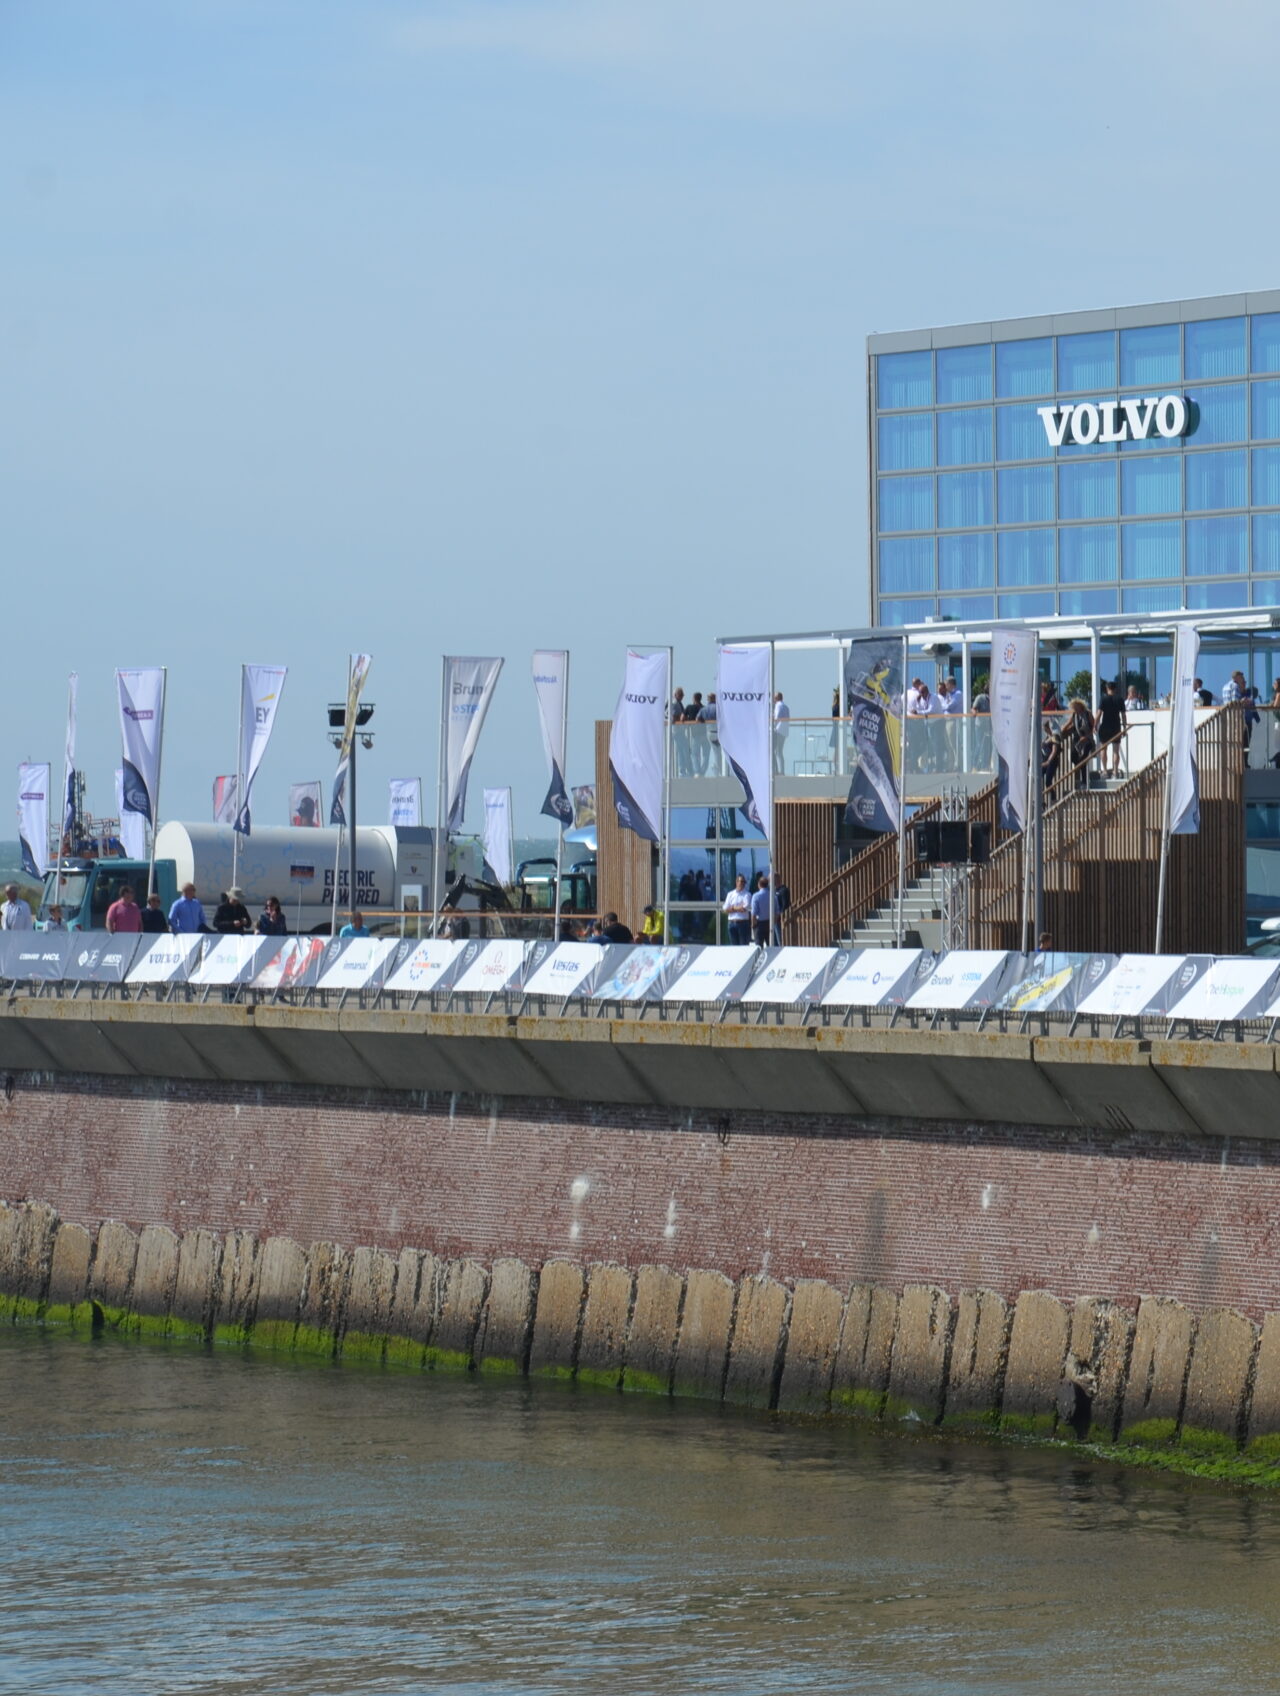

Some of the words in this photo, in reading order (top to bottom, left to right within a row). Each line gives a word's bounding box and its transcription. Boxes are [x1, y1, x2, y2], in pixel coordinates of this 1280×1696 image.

[1037, 395, 1186, 447] VOLVO
[255, 707, 270, 724] EY
[324, 869, 376, 887] ELECRIC
[322, 887, 380, 904] PWRED
